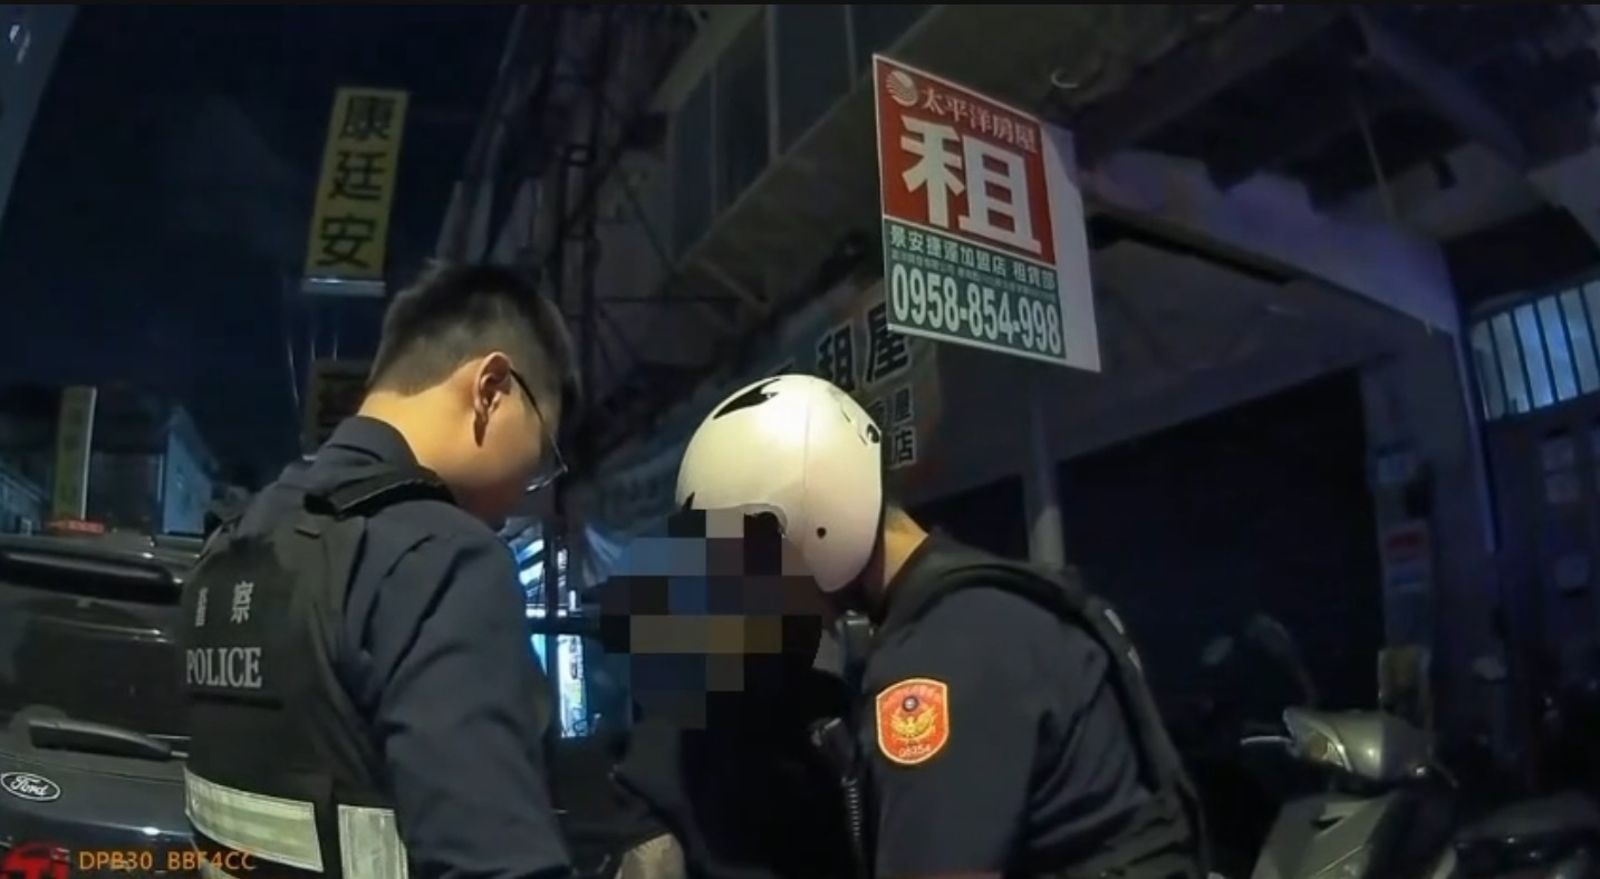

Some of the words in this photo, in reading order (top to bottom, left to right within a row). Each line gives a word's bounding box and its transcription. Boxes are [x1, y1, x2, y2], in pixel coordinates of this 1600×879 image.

[921, 87, 1038, 153] 太平洋房屋
[316, 94, 397, 269] 康廷安
[901, 115, 1042, 255] 租
[891, 263, 1062, 354] 0958-854-998
[185, 646, 262, 689] POLICE
